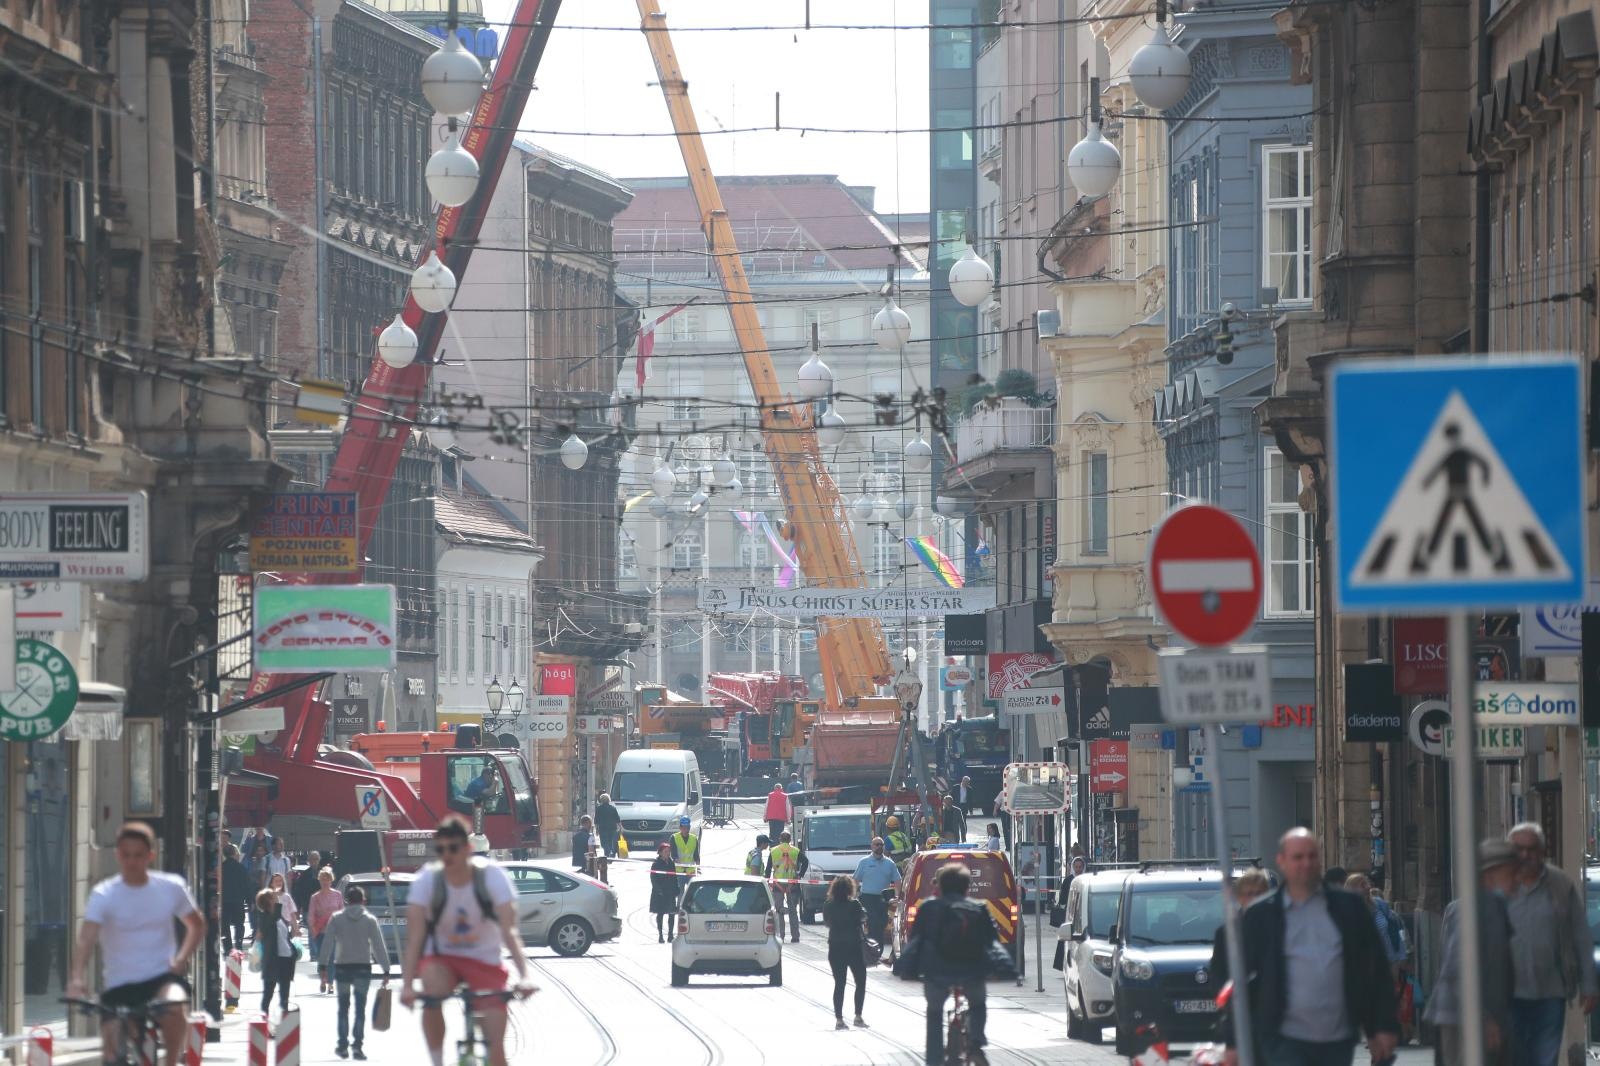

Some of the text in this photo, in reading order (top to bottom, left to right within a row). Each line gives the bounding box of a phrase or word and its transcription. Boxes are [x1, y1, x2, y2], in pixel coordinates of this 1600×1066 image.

[261, 495, 352, 514] RINT
[0, 511, 44, 549] BODY
[54, 511, 121, 549] FEELING
[254, 514, 354, 537] CENTAR
[264, 539, 342, 550] POZIVNICE
[66, 564, 125, 575] WEIDER
[256, 554, 349, 567] IZRADA NATPISA
[738, 590, 964, 611] JESUS CHRIST SUPER STAR
[1404, 643, 1449, 662] LISC
[1474, 692, 1576, 714] aš dom
[0, 715, 53, 735] PUB
[529, 721, 564, 732] ecco
[1086, 721, 1110, 730] adid
[1347, 713, 1401, 728] diadema
[1446, 727, 1523, 748] PIKER
